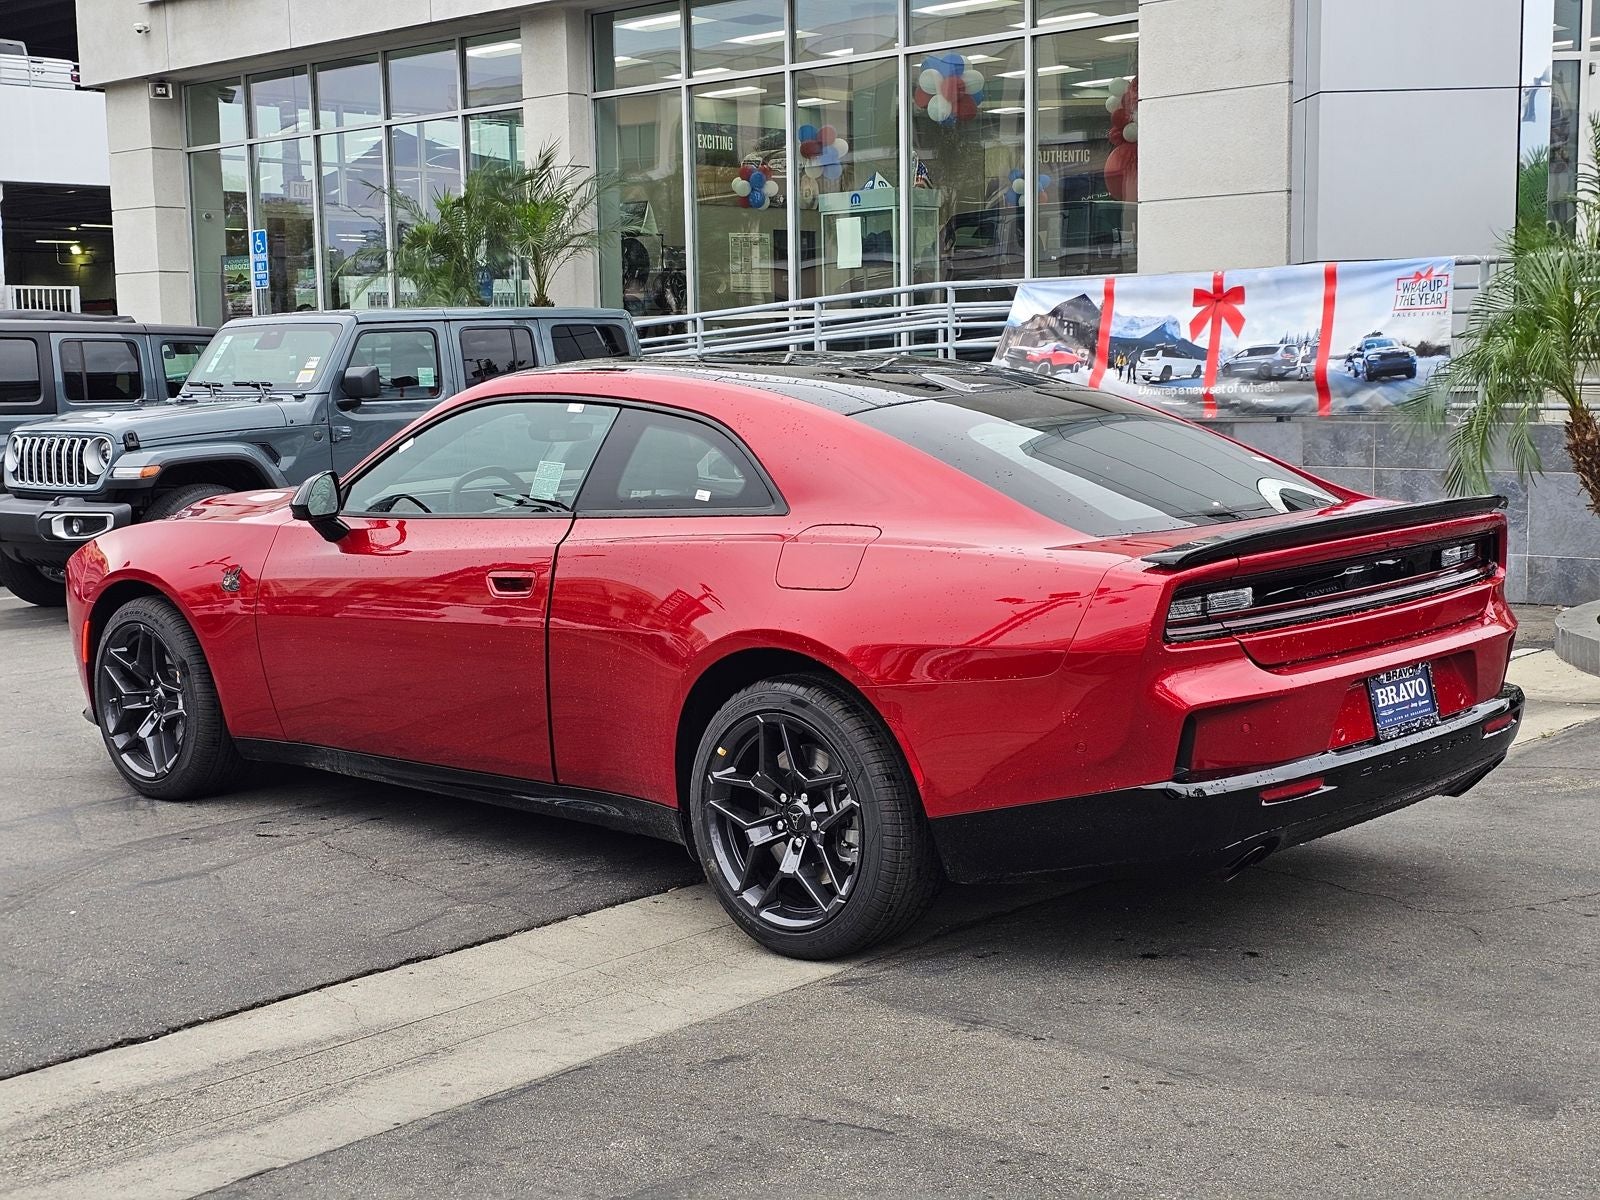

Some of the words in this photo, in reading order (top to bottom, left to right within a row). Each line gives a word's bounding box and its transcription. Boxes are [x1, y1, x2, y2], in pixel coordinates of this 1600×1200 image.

[697, 134, 733, 151] EXCITING
[1037, 149, 1091, 164] AUTHENTIC
[1402, 280, 1428, 293] WRAP
[1429, 279, 1443, 292] UP
[1399, 294, 1416, 306] THE
[1418, 292, 1443, 306] YEAR
[1138, 385, 1177, 397] Unwrap
[1179, 387, 1186, 395] a
[1186, 386, 1207, 395] new
[1209, 384, 1226, 394] set
[1227, 383, 1241, 393] of
[1385, 666, 1414, 682] BRAVO
[1375, 677, 1427, 708] BRAVO
